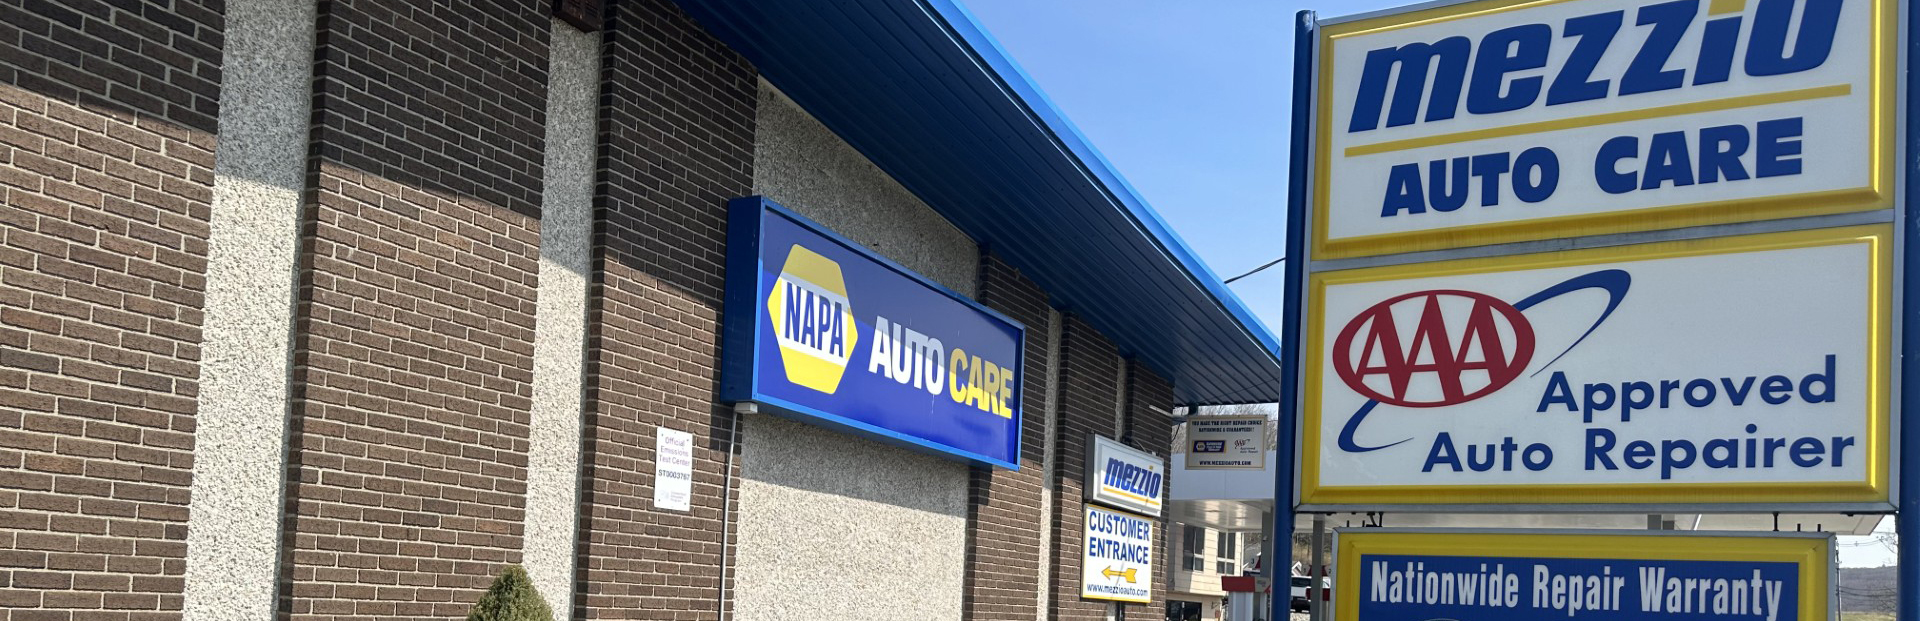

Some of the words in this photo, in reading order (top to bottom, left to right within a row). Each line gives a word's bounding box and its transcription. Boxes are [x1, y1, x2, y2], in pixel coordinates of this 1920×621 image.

[1348, 0, 1842, 133] mezzio
[1380, 146, 1560, 217] AUTO
[1594, 117, 1803, 194] CARE
[785, 281, 843, 358] NAPA
[868, 315, 945, 396] AUTO
[949, 348, 1013, 419] CARE
[1347, 290, 1518, 406] AAA
[1536, 354, 1836, 423] Approved
[659, 454, 671, 464] Test
[672, 457, 690, 466] Center
[661, 446, 689, 457] Emissions
[665, 437, 685, 447] Official
[1422, 432, 1554, 473] Auto
[1584, 423, 1855, 479] Repairer
[1103, 457, 1162, 499] mezzio
[1088, 536, 1149, 564] ENTRANCE
[1089, 511, 1150, 541] CUSTOMER
[1087, 583, 1148, 597] www.mezzioauto.com
[1371, 561, 1519, 608] Nationwide
[1532, 564, 1625, 617] Repair
[1638, 566, 1782, 620] Warranty
